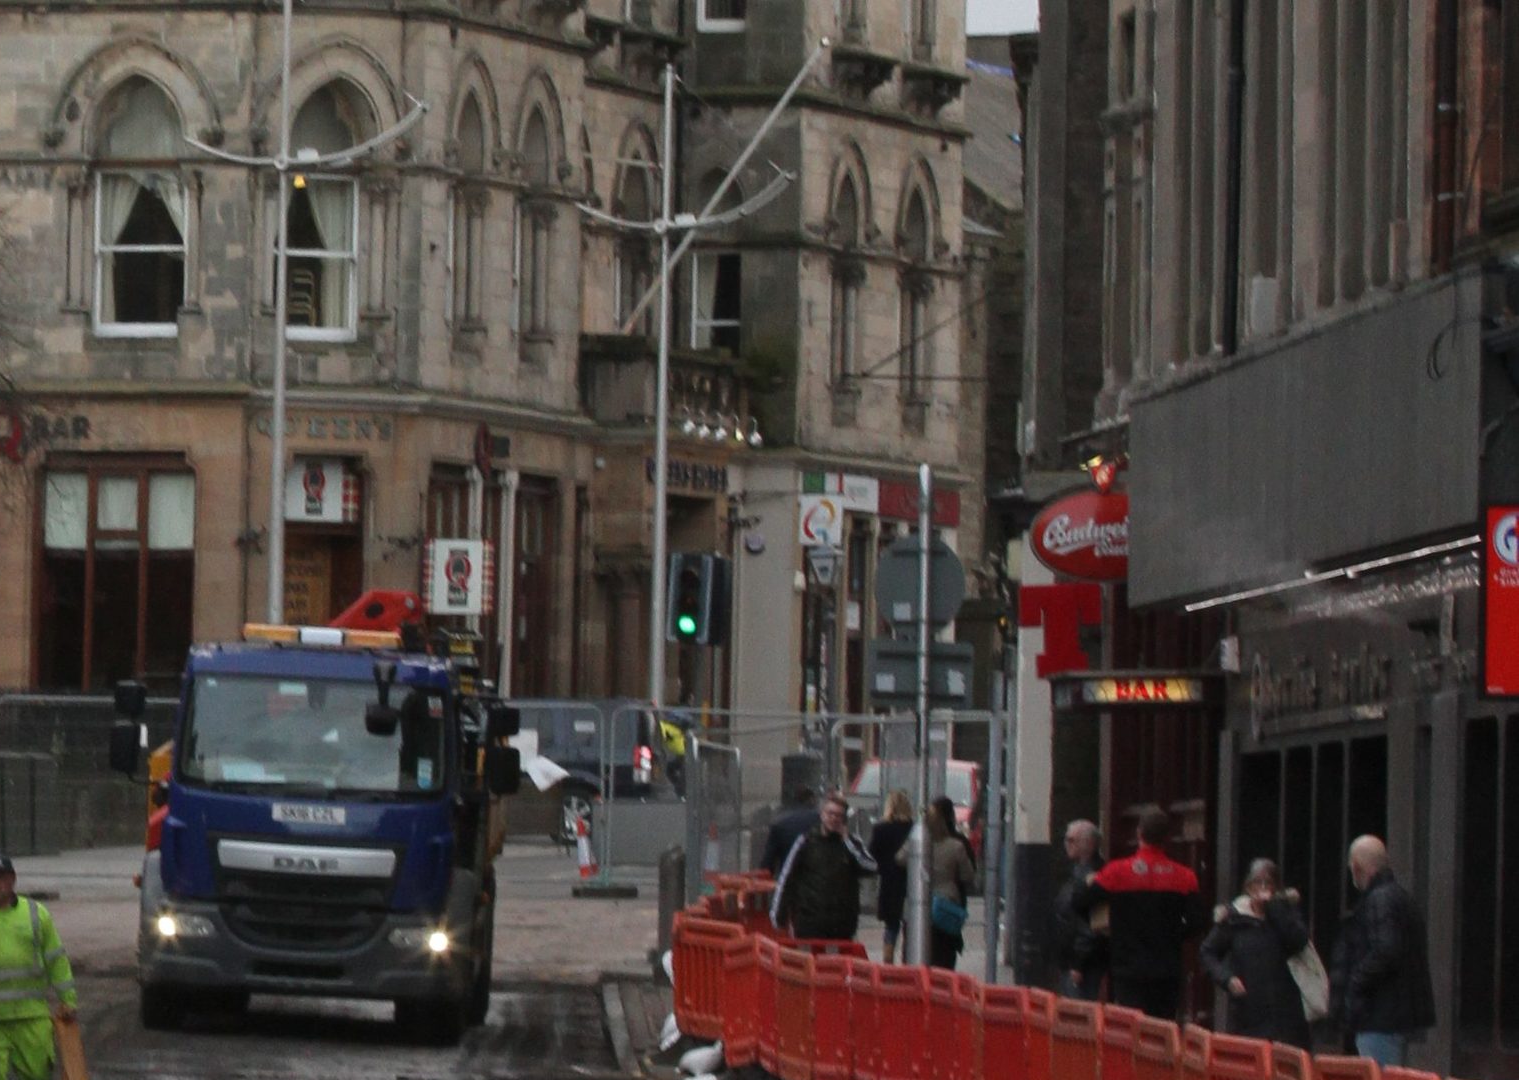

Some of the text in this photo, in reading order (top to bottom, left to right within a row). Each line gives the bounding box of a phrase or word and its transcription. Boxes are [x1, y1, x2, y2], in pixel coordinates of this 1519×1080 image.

[1043, 514, 1129, 556] Budwei
[1115, 679, 1168, 700] BAR
[273, 857, 340, 873] DAF
